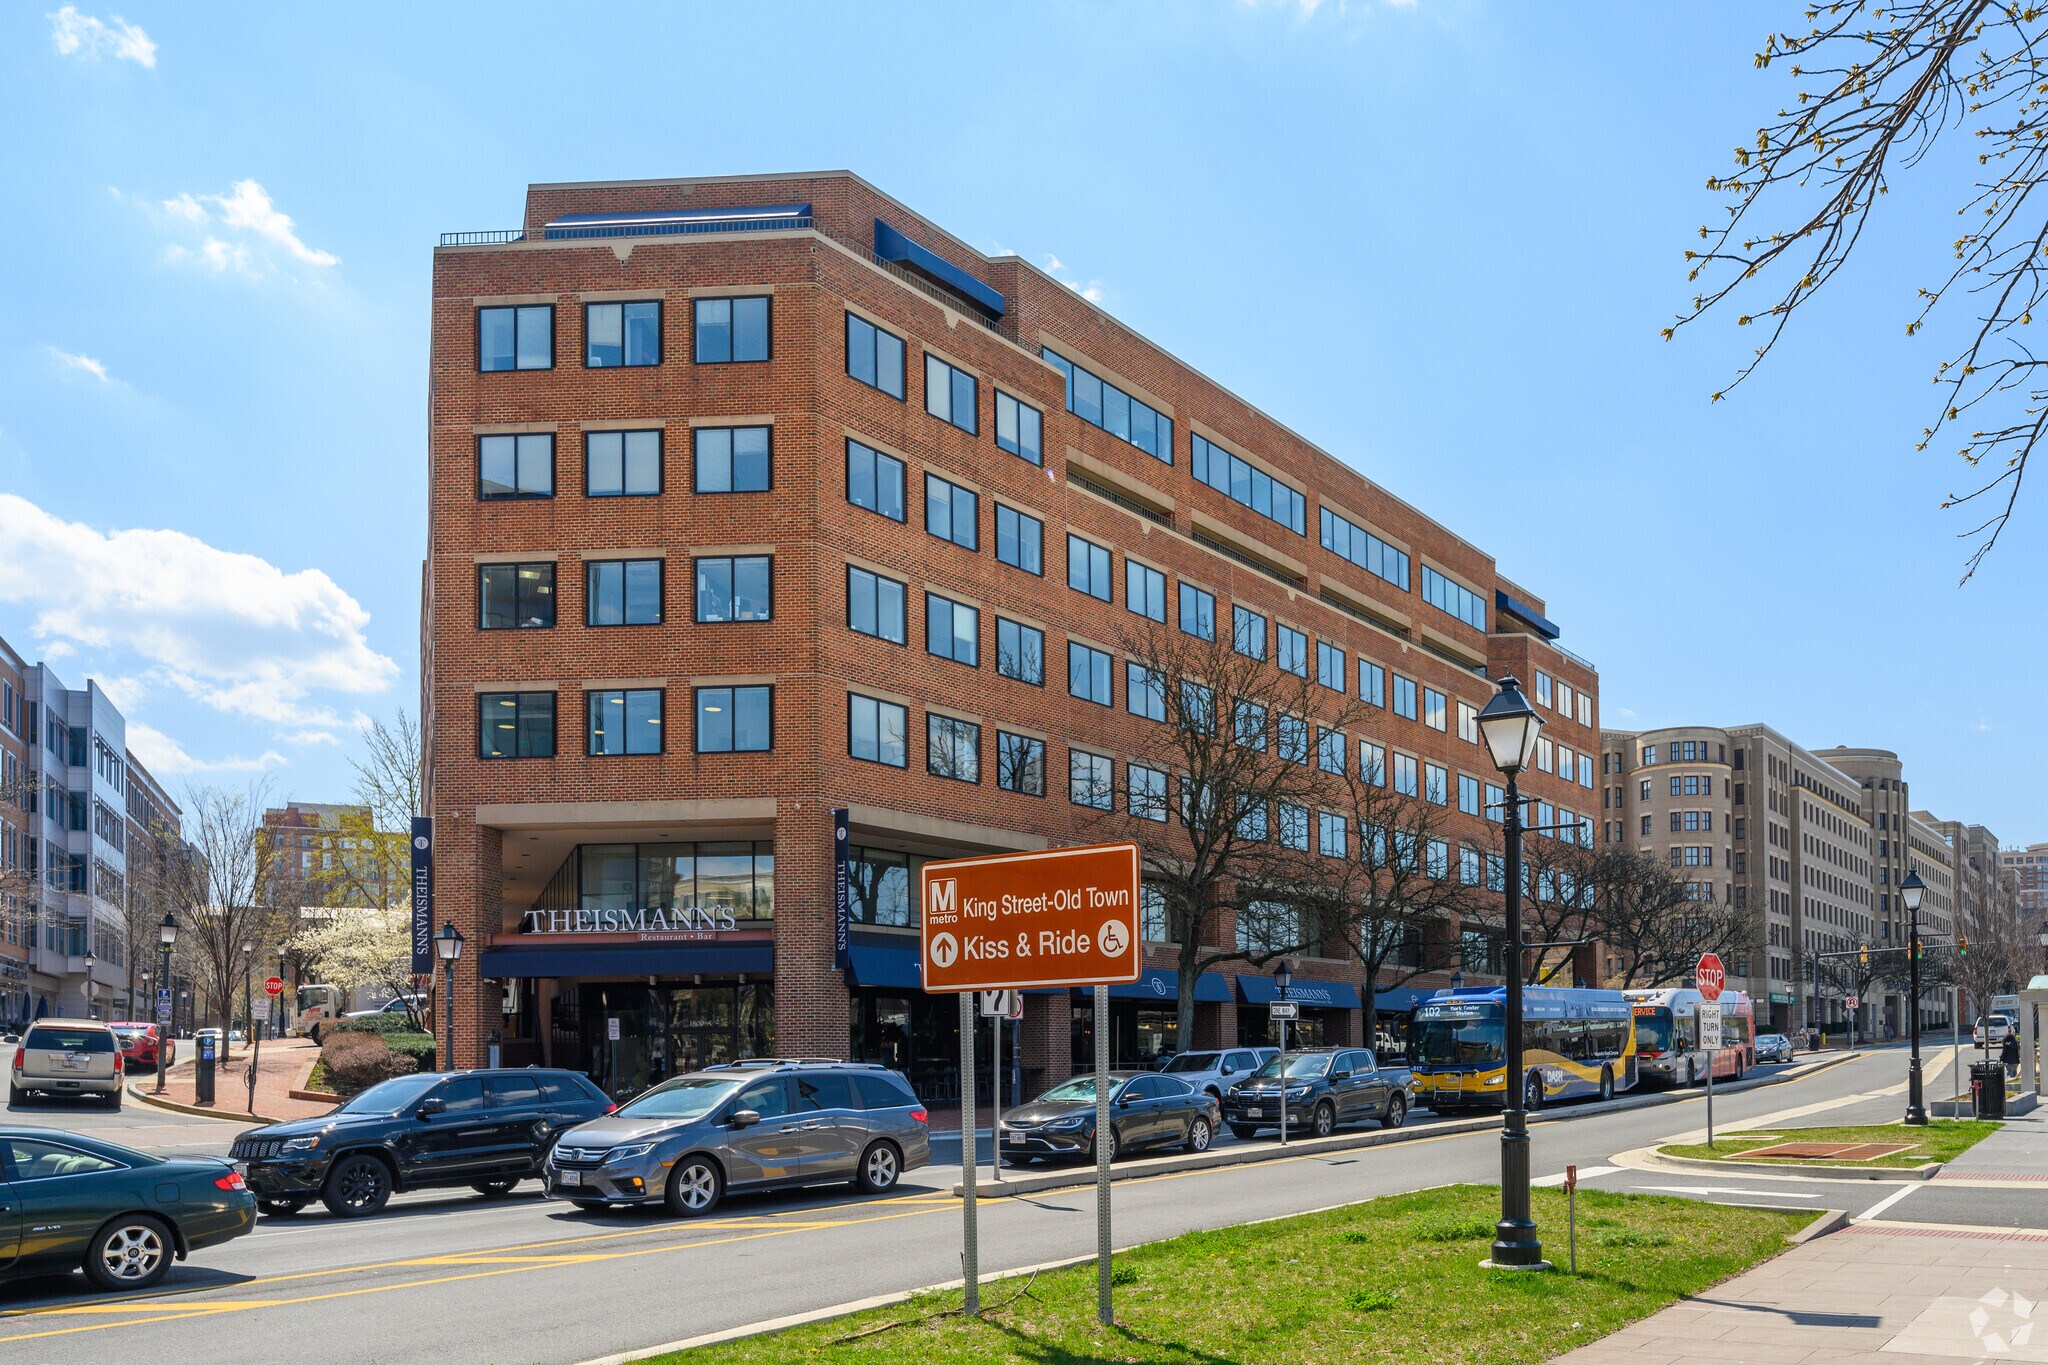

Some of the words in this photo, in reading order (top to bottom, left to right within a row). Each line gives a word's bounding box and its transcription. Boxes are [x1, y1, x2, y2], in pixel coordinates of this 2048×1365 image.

[931, 880, 955, 912] M
[838, 861, 846, 951] THEISMANN'S
[963, 897, 997, 922] King
[1001, 888, 1081, 915] Street-Old
[1086, 886, 1129, 908] Town
[416, 866, 428, 955] THEISMANN'S
[524, 904, 737, 933] THEISMANN'S
[929, 914, 958, 925] metro
[641, 933, 688, 941] Restaurant
[697, 932, 713, 940] Bar
[964, 935, 1009, 960] Kiss
[1016, 932, 1032, 958] &
[1039, 929, 1091, 956] Ride
[1698, 968, 1723, 987] STOP
[265, 981, 283, 990] STOP
[1275, 986, 1332, 1000] TEISMANN'S
[1272, 1006, 1281, 1014] ONE
[1282, 1006, 1291, 1014] WAY
[1424, 1006, 1441, 1018] 102
[1634, 1007, 1656, 1016] ERVICE
[1701, 1009, 1720, 1019] RIGHT
[1703, 1022, 1720, 1031] TURN
[1702, 1035, 1720, 1044] ONLY
[1547, 1070, 1563, 1082] DASH
